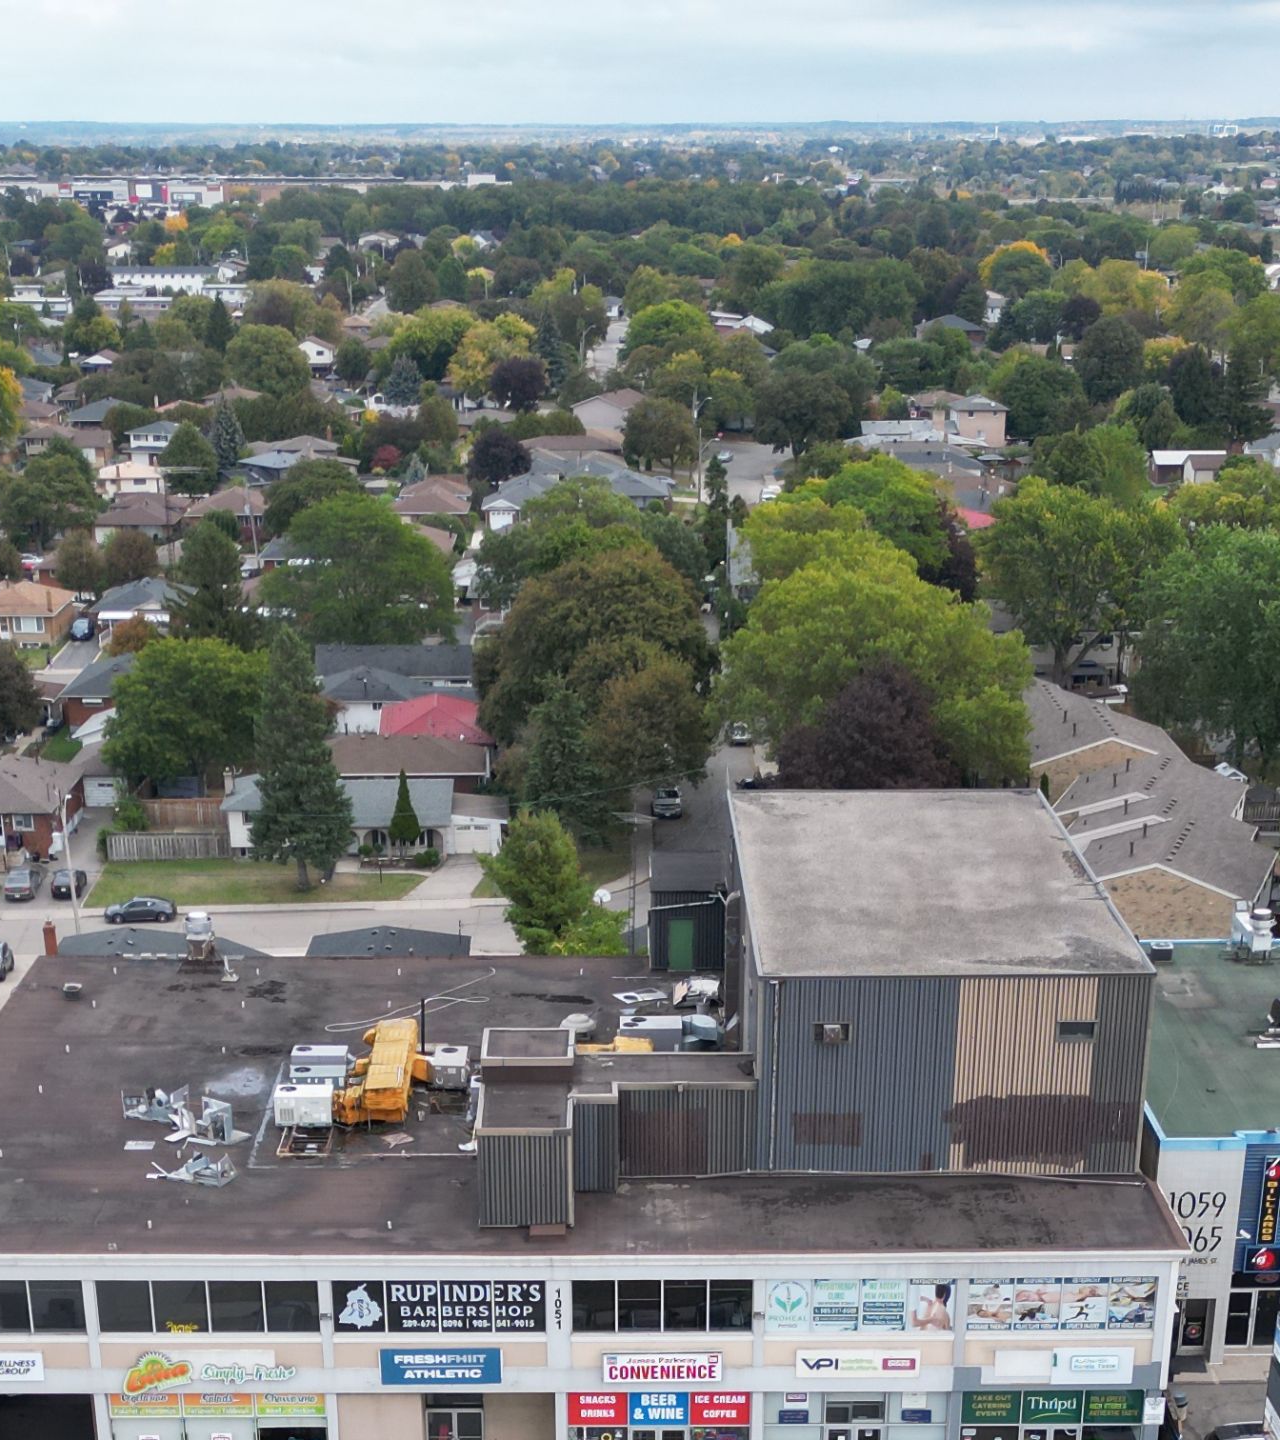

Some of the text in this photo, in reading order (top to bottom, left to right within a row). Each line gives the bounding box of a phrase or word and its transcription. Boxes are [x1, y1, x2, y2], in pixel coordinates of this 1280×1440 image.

[801, 1358, 839, 1371] VPI
[403, 1369, 482, 1379] ATHLETIC
[609, 1365, 717, 1380] CONVENIENCE
[579, 1396, 617, 1404] SNACKS
[640, 1394, 677, 1406] BEER
[694, 1395, 746, 1404] ICE CREAM
[580, 1409, 616, 1417] DRINKS
[633, 1408, 684, 1420] & WINE
[703, 1410, 737, 1418] COFFEE
